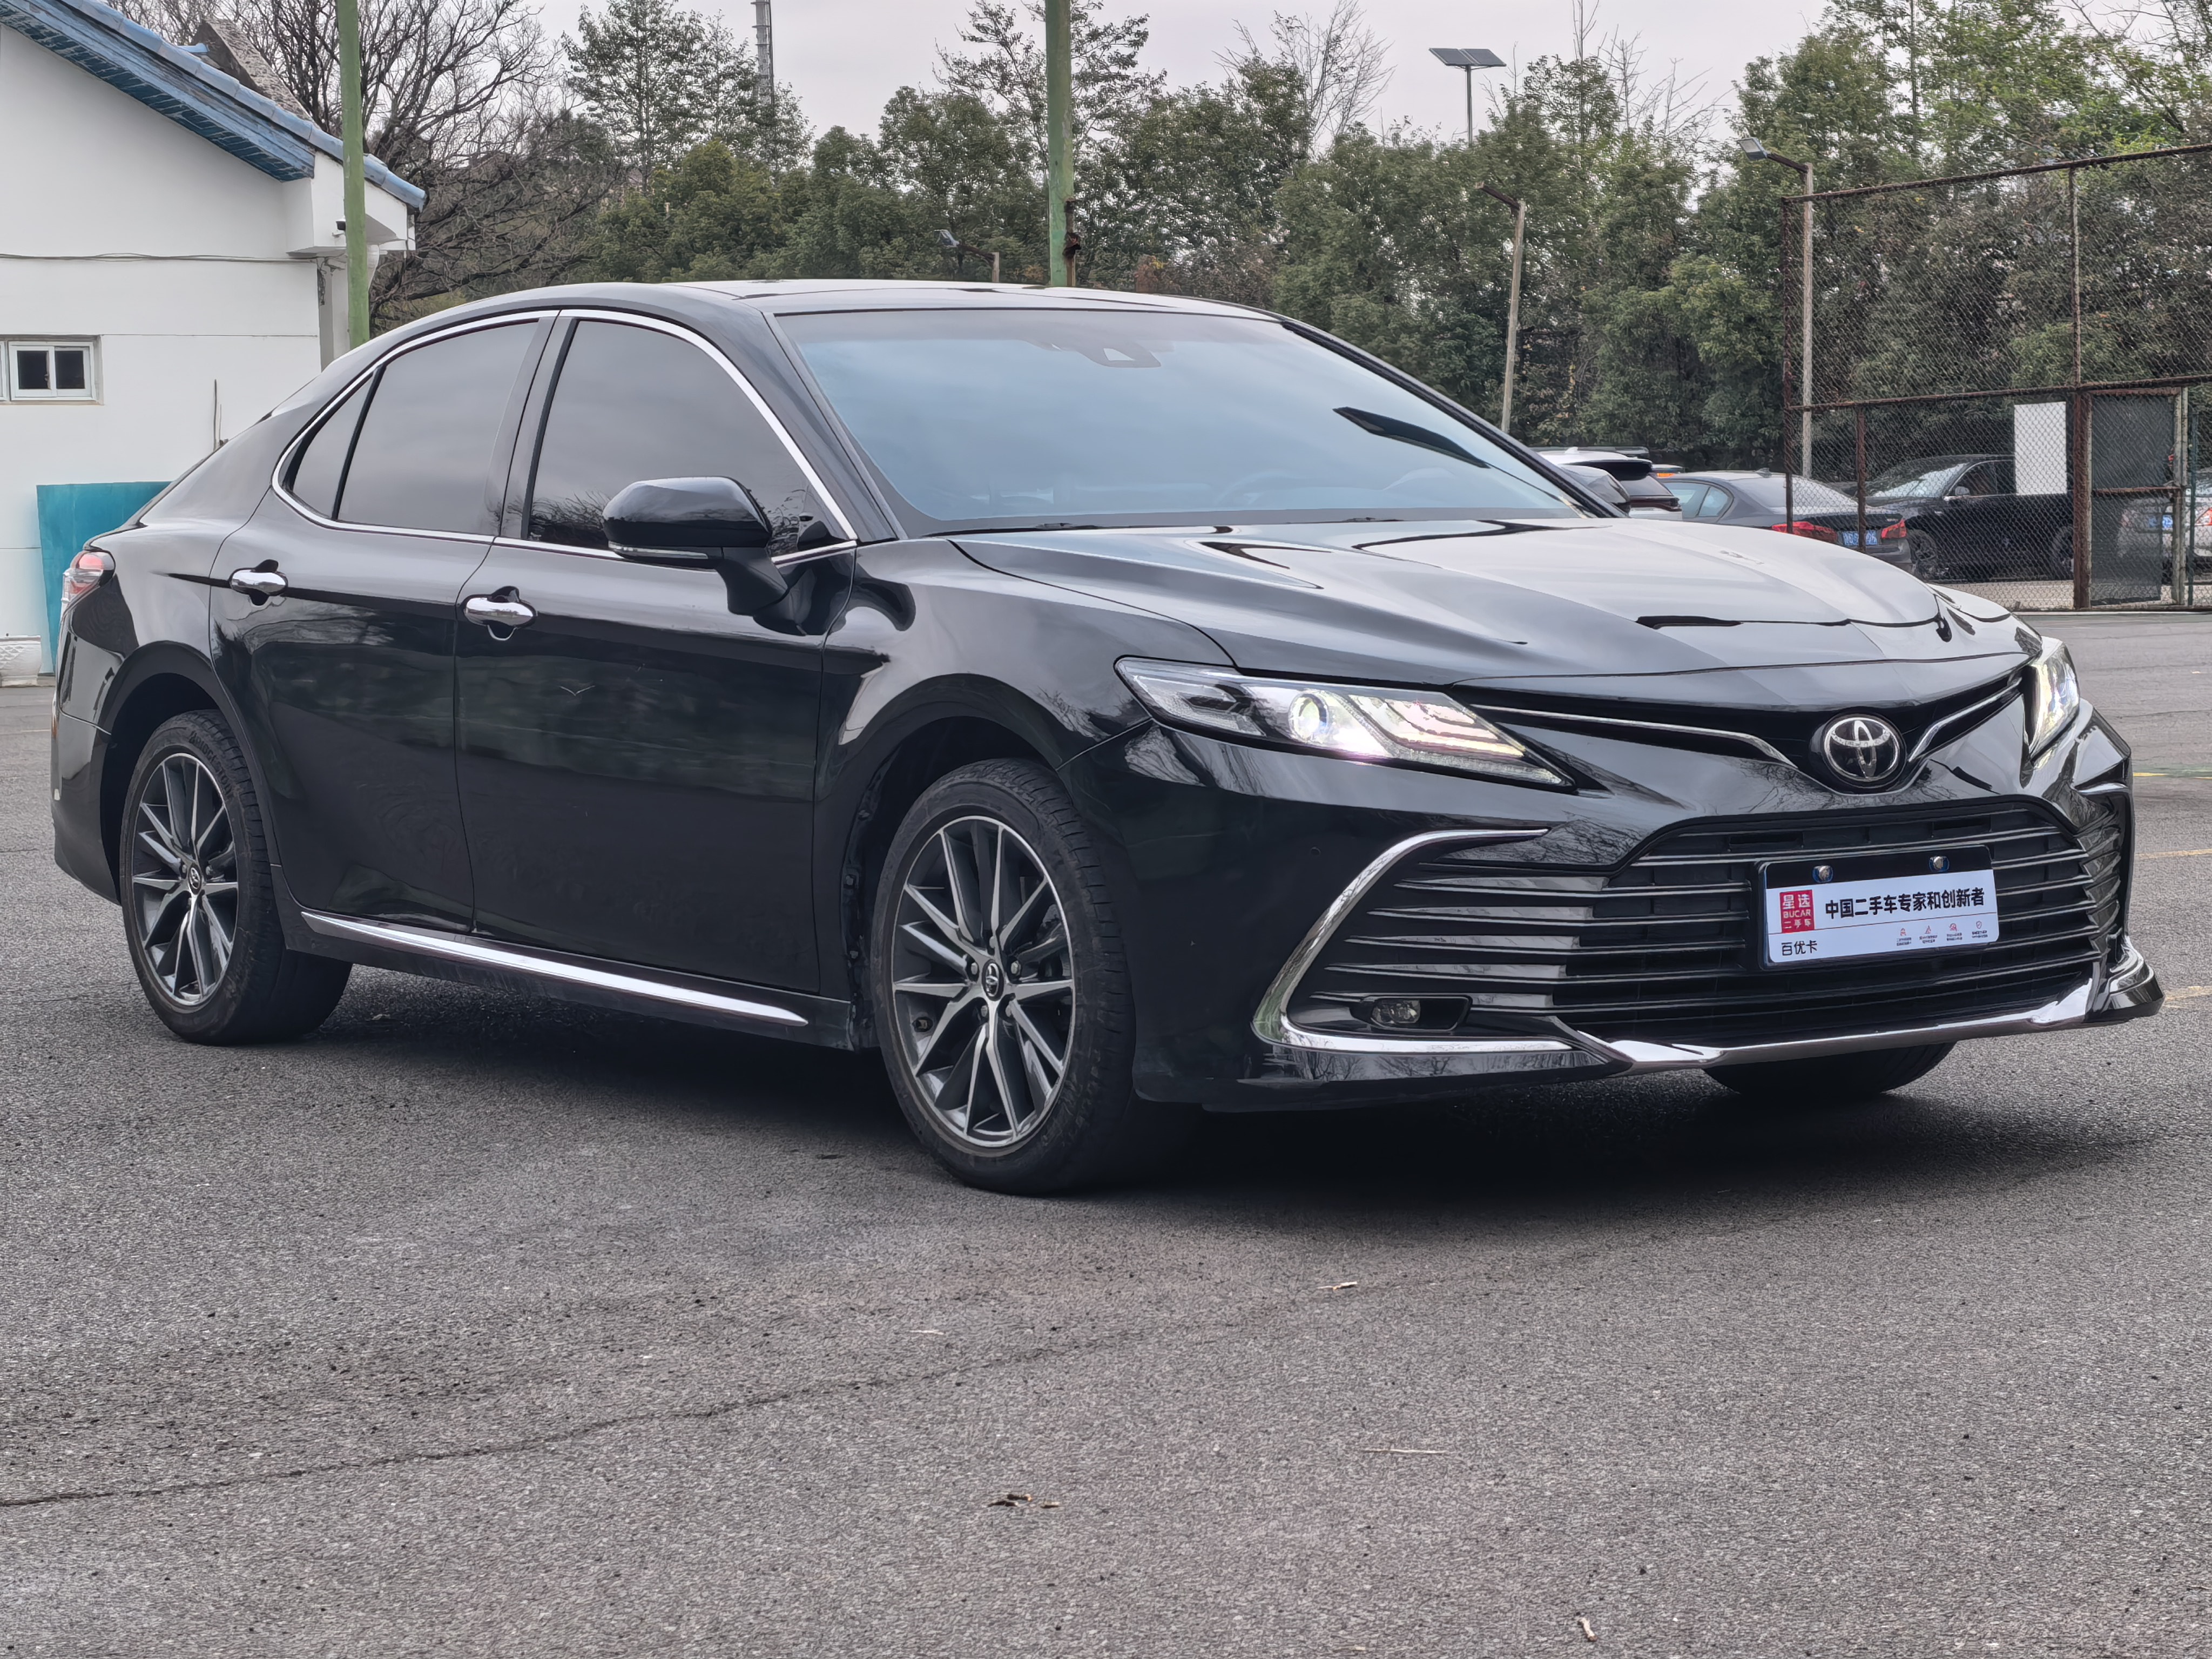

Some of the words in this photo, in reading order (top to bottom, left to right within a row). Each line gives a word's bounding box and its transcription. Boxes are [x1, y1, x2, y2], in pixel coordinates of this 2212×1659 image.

[1783, 894, 1811, 910] 星选
[1825, 887, 1985, 919] 中国二手车专家和创新者
[1783, 909, 1811, 919] BUCAR
[1784, 919, 1812, 929] 二手车
[1781, 940, 1818, 956] 百优卡
